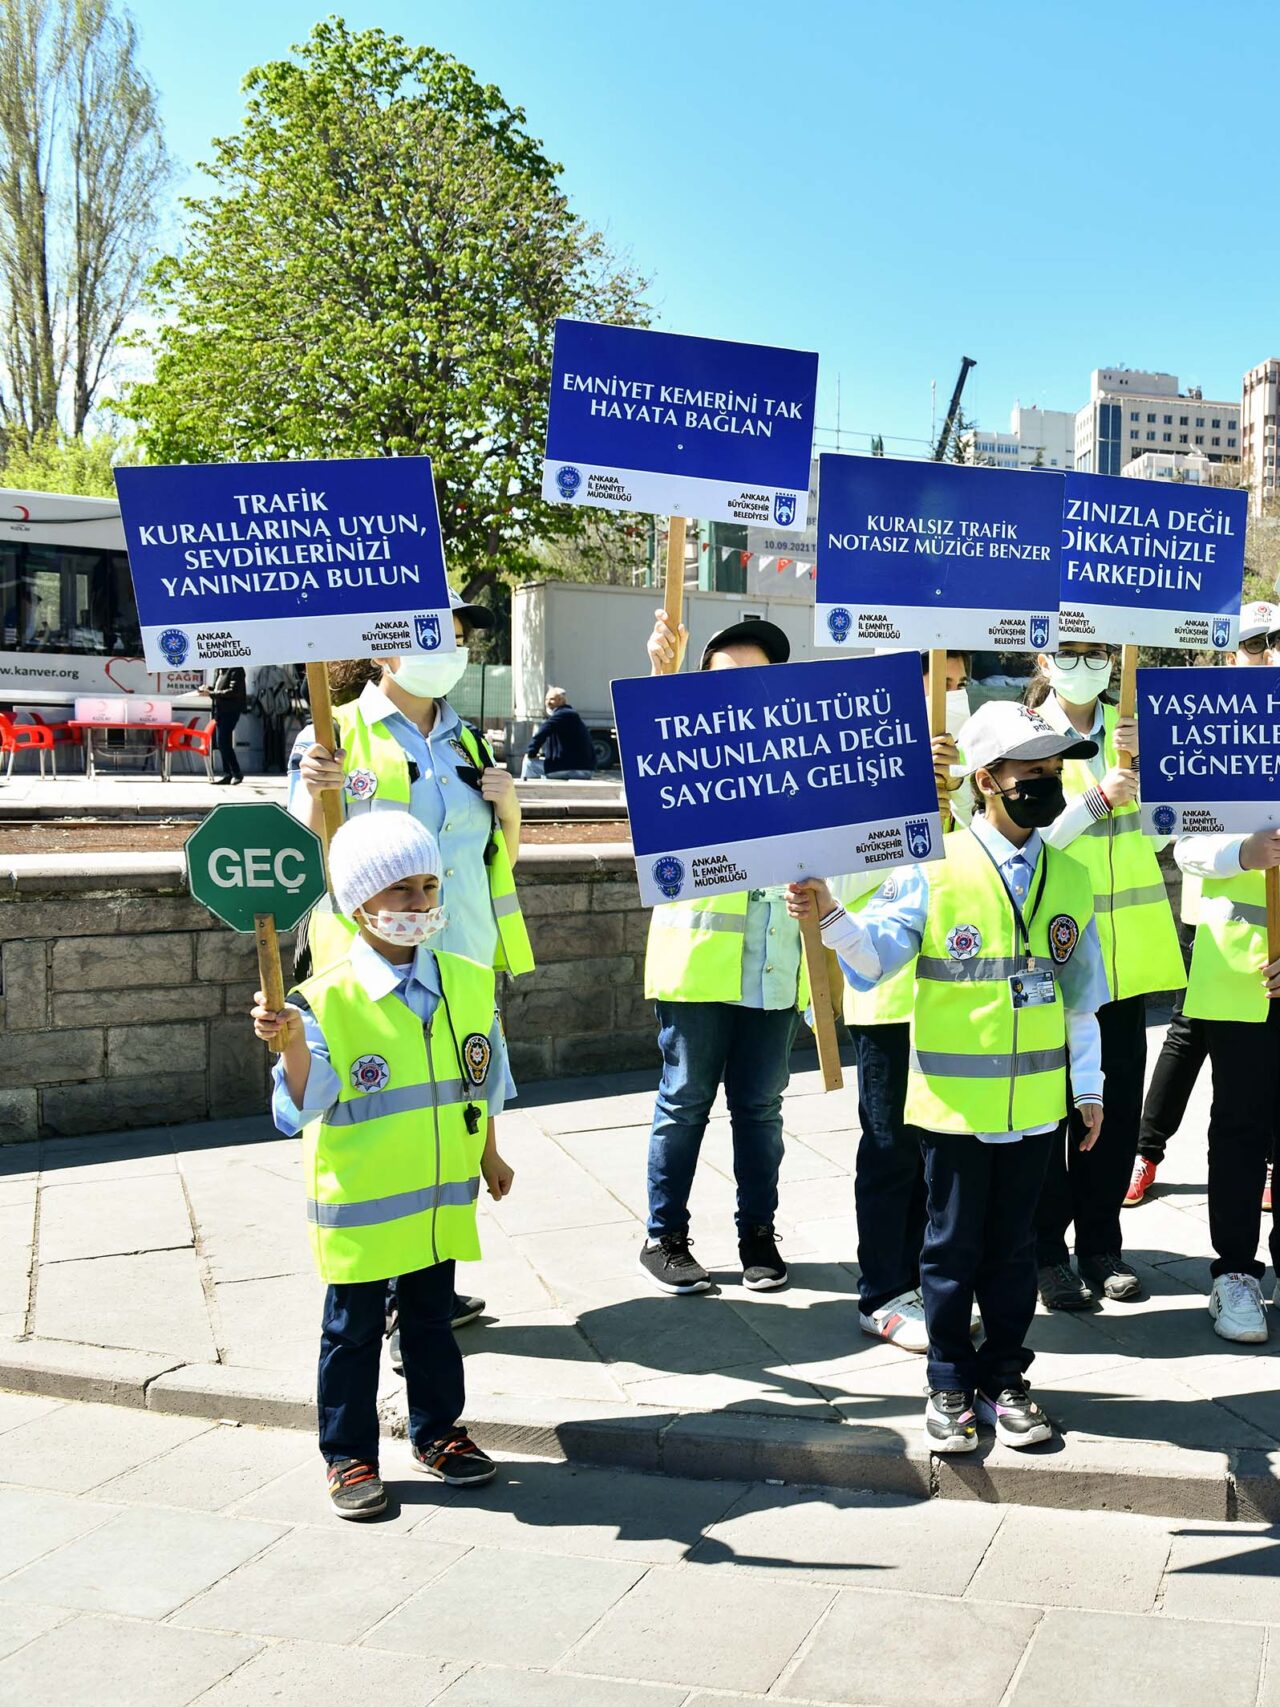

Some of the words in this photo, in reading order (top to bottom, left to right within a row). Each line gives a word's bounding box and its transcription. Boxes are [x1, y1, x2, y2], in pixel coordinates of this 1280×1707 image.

[563, 373, 654, 400] EMNİYET
[660, 385, 757, 414] KEMERİNİ
[764, 399, 802, 419] TAK
[590, 399, 678, 426] HAYATA
[685, 410, 772, 437] BAĞLAN
[588, 474, 619, 483] ANKARA
[595, 484, 625, 493] EMNİYET
[234, 488, 328, 515] TRAFİK
[587, 490, 632, 501] MÜDÜRLÜĞÜ
[740, 493, 770, 502] ANKARA
[728, 500, 770, 511] BÜYÜKŞEHİR
[733, 510, 769, 521] BELEDİYESİ
[1066, 500, 1160, 528] ZINIZLA
[1168, 508, 1234, 536] DEĞİL
[139, 518, 330, 546] KURALLARINA
[340, 514, 427, 536] UYUN,
[867, 515, 954, 535] KURALSIZ
[960, 520, 1018, 539] TRAFİK
[765, 541, 810, 551] 10.09.2021
[828, 534, 910, 553] NOTASIZ
[914, 536, 984, 557] MÜZİĞE
[989, 544, 1051, 561] BENZER
[1062, 526, 1216, 563] DİKKATİNİZLE
[185, 537, 391, 570] SEVDİKLERİNİZİ
[161, 571, 319, 597] YANINIZDA
[328, 565, 420, 588] BULUN
[1068, 561, 1202, 591] FARKEDİLİN
[375, 620, 409, 630] ANKARA
[858, 621, 864, 629] İL
[1065, 619, 1089, 627] EMNİYET
[362, 629, 410, 641] BÜYÜKŞEHİR
[858, 630, 900, 639] MÜDÜRLÜĞÜ
[989, 626, 1026, 636] BÜYÜKŞEHİR
[1059, 625, 1096, 634] MÜDÜRLÜĞÜ
[1175, 627, 1208, 636] BÜYÜKŞEHİR
[196, 631, 232, 641] ANKARA
[994, 636, 1025, 645] BELEDİYESİ
[197, 641, 204, 649] İL
[206, 639, 242, 650] EMNİYET
[371, 639, 412, 650] BELEDİYESİ
[199, 647, 251, 658] MÜDÜRLÜĞÜ
[0, 666, 79, 679] w.kanver.org
[1148, 693, 1258, 720] YAŞAMA
[655, 705, 756, 740] TRAFİK
[763, 688, 891, 728] KÜLTÜRÜ
[637, 734, 832, 778] KANUNLARLA
[839, 718, 917, 752] DEĞİL
[660, 770, 800, 810] SAYGIYLA
[807, 753, 905, 788] GELİŞİR
[1183, 824, 1224, 832] MÜDÜRLÜĞÜ
[868, 829, 901, 841] ANKARA
[856, 839, 903, 854] BÜYÜKŞEHİR
[692, 855, 728, 867] ANKARA
[865, 850, 905, 864] BELEDİYESİ
[208, 847, 306, 893] GEÇ
[693, 868, 700, 877] İL
[701, 864, 736, 876] EMNİYET
[694, 870, 748, 888] MÜDÜRLÜĞÜ
